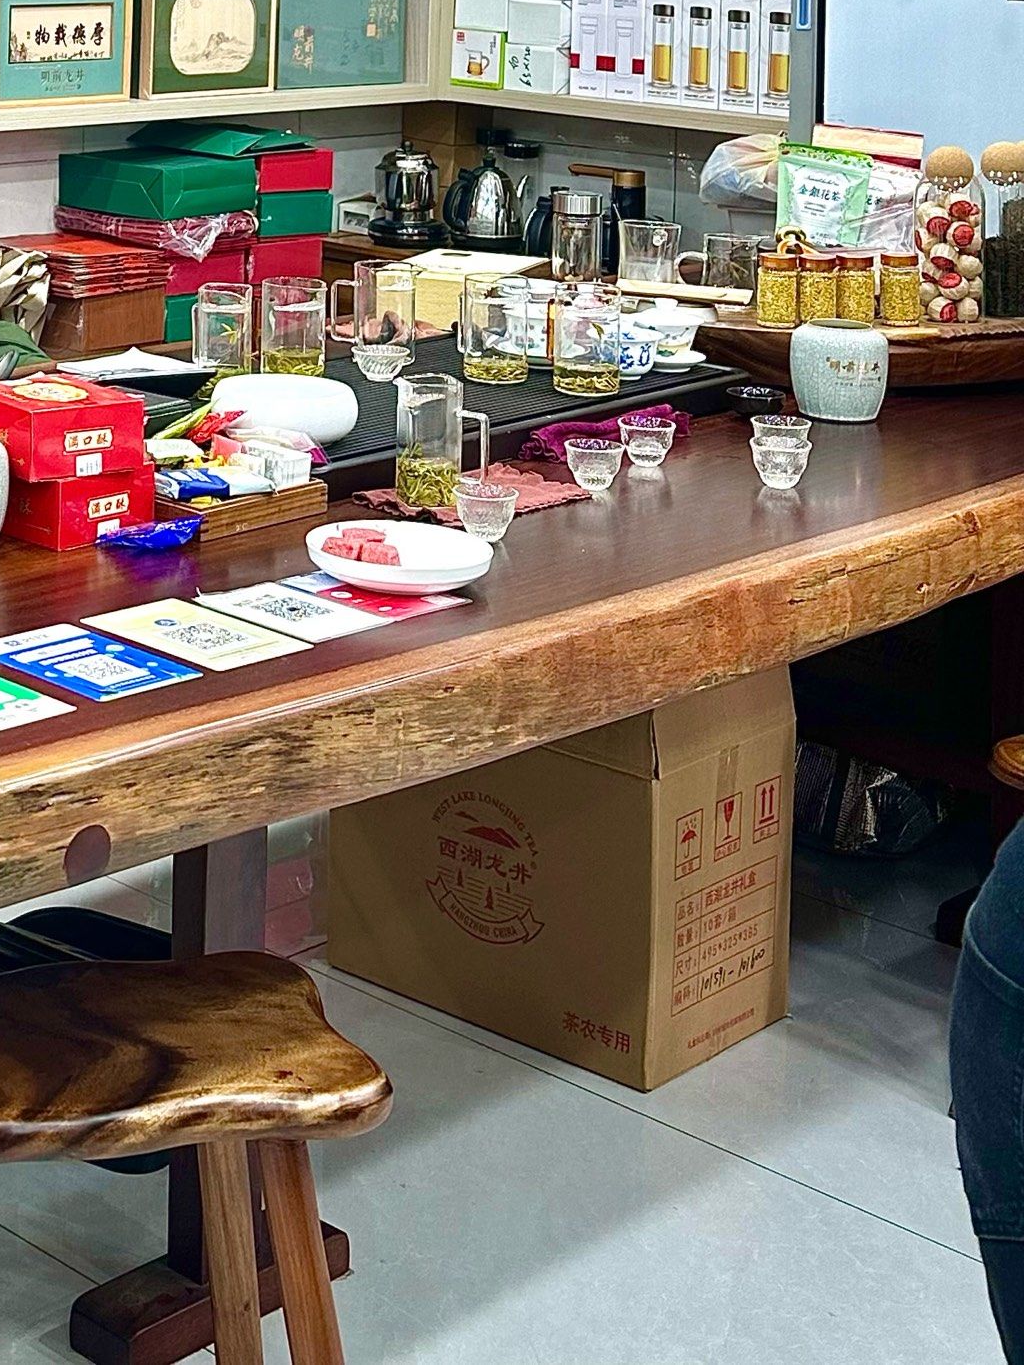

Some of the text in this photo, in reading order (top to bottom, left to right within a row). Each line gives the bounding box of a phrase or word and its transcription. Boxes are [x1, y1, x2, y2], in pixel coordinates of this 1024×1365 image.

[431, 798, 453, 824] WEST
[450, 790, 477, 805] LAKE
[478, 791, 526, 832] LONGJING
[437, 835, 533, 885] 西湖龙井
[562, 1010, 631, 1054] 茶农专用
